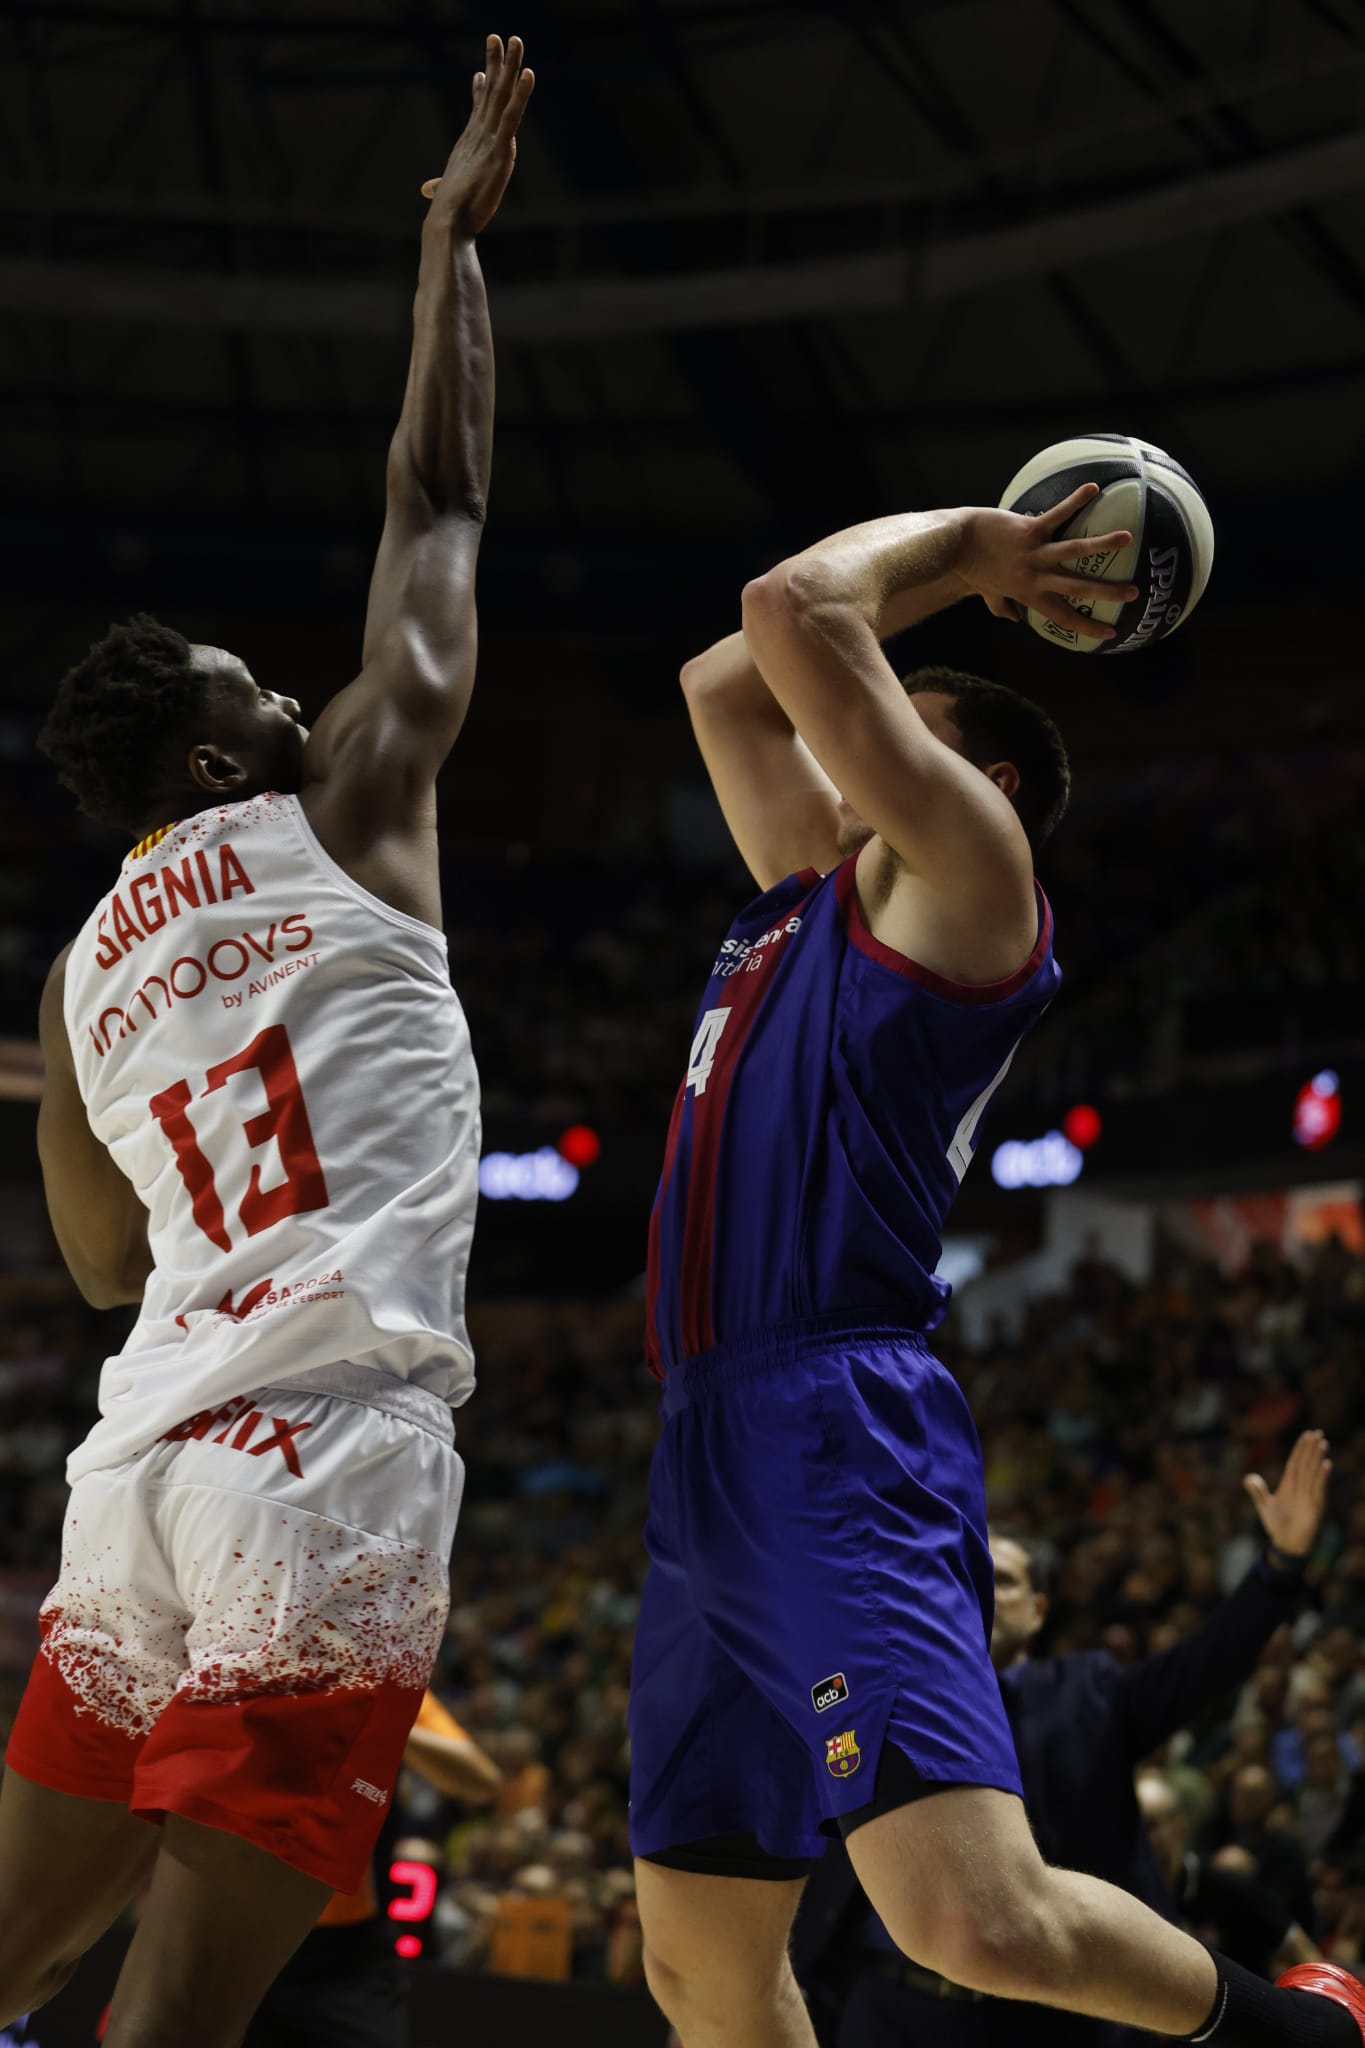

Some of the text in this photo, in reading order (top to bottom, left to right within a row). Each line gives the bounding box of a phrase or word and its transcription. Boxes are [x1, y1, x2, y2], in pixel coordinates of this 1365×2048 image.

[95, 843, 256, 971] SAGNIA
[221, 951, 321, 1009] by AVINENT
[684, 1006, 733, 1098] 4
[149, 1023, 330, 1254] 13
[816, 1689, 839, 1708] acb
